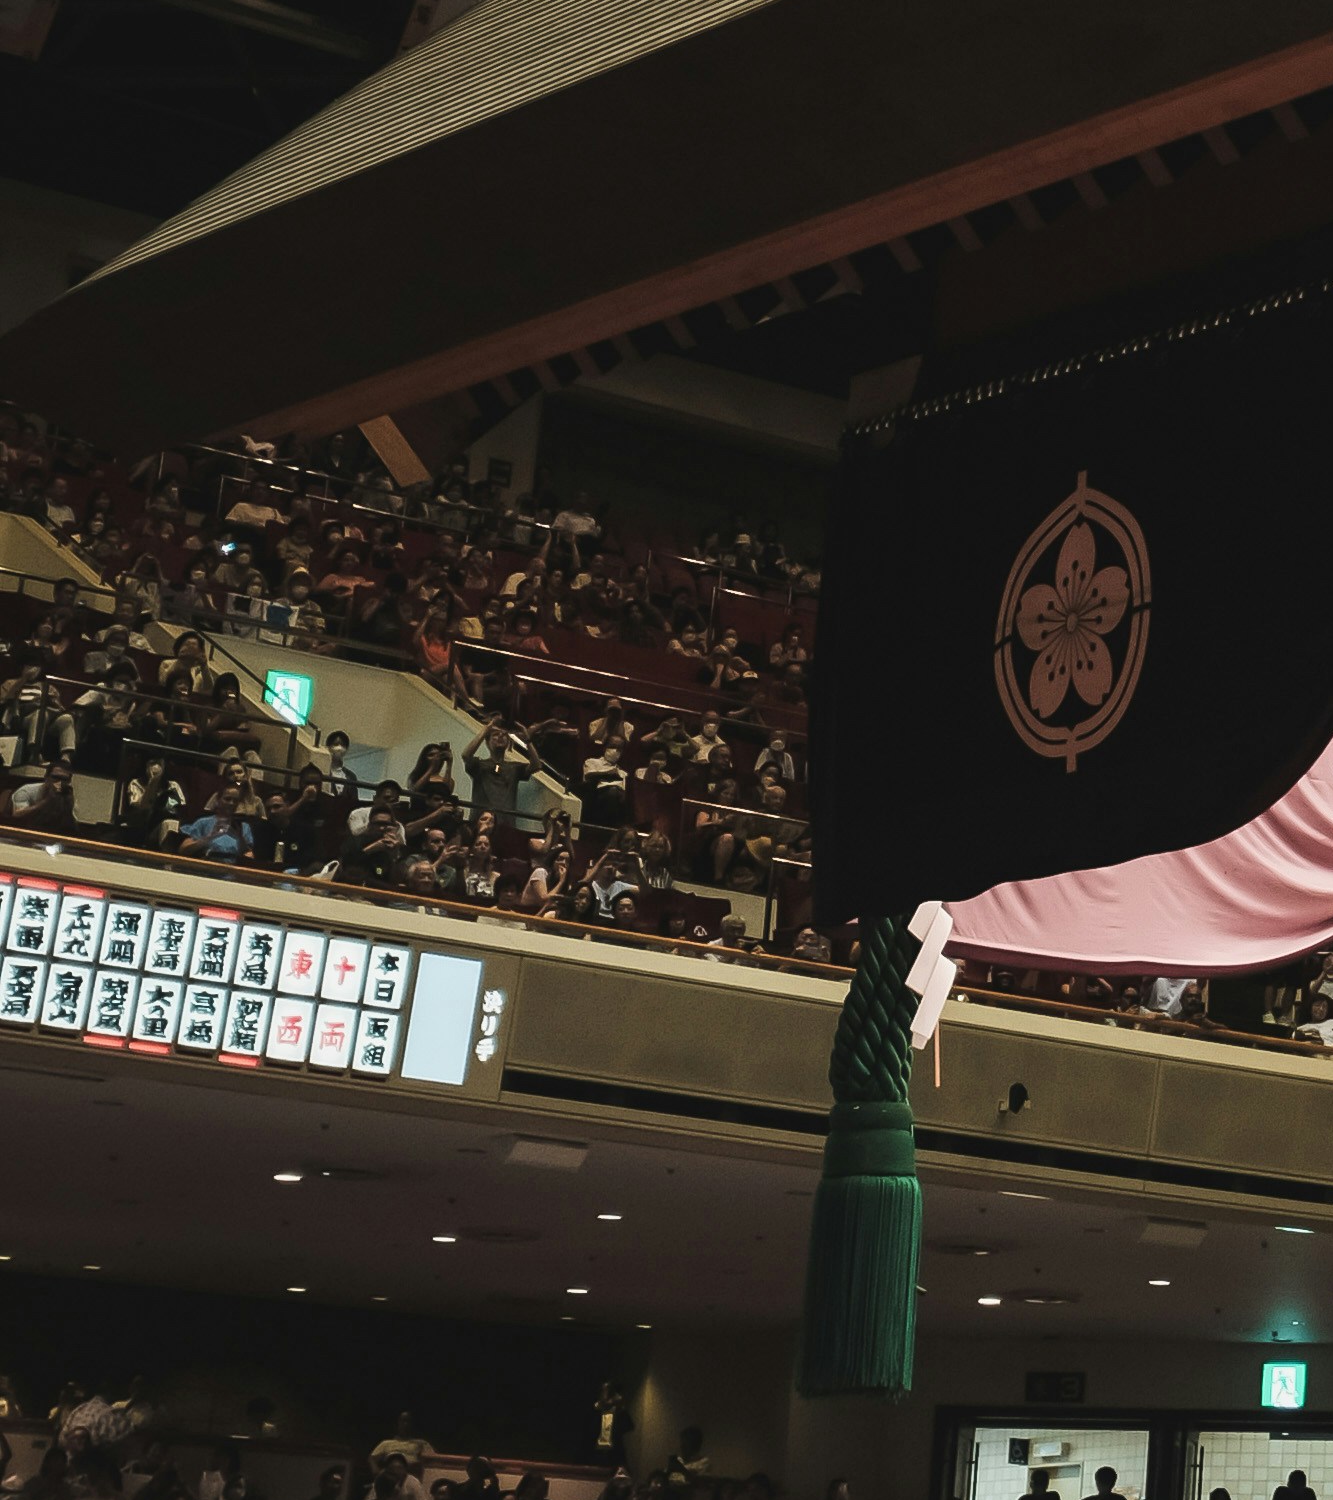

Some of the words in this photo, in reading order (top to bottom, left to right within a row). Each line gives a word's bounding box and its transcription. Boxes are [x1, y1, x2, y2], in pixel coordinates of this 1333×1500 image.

[61, 904, 94, 956] 千代丸
[286, 949, 313, 979] 東
[334, 955, 357, 985] 十
[374, 952, 400, 1002] 本日
[142, 985, 174, 1038] 大の里
[278, 1015, 302, 1045] 西
[319, 1022, 345, 1052] 両
